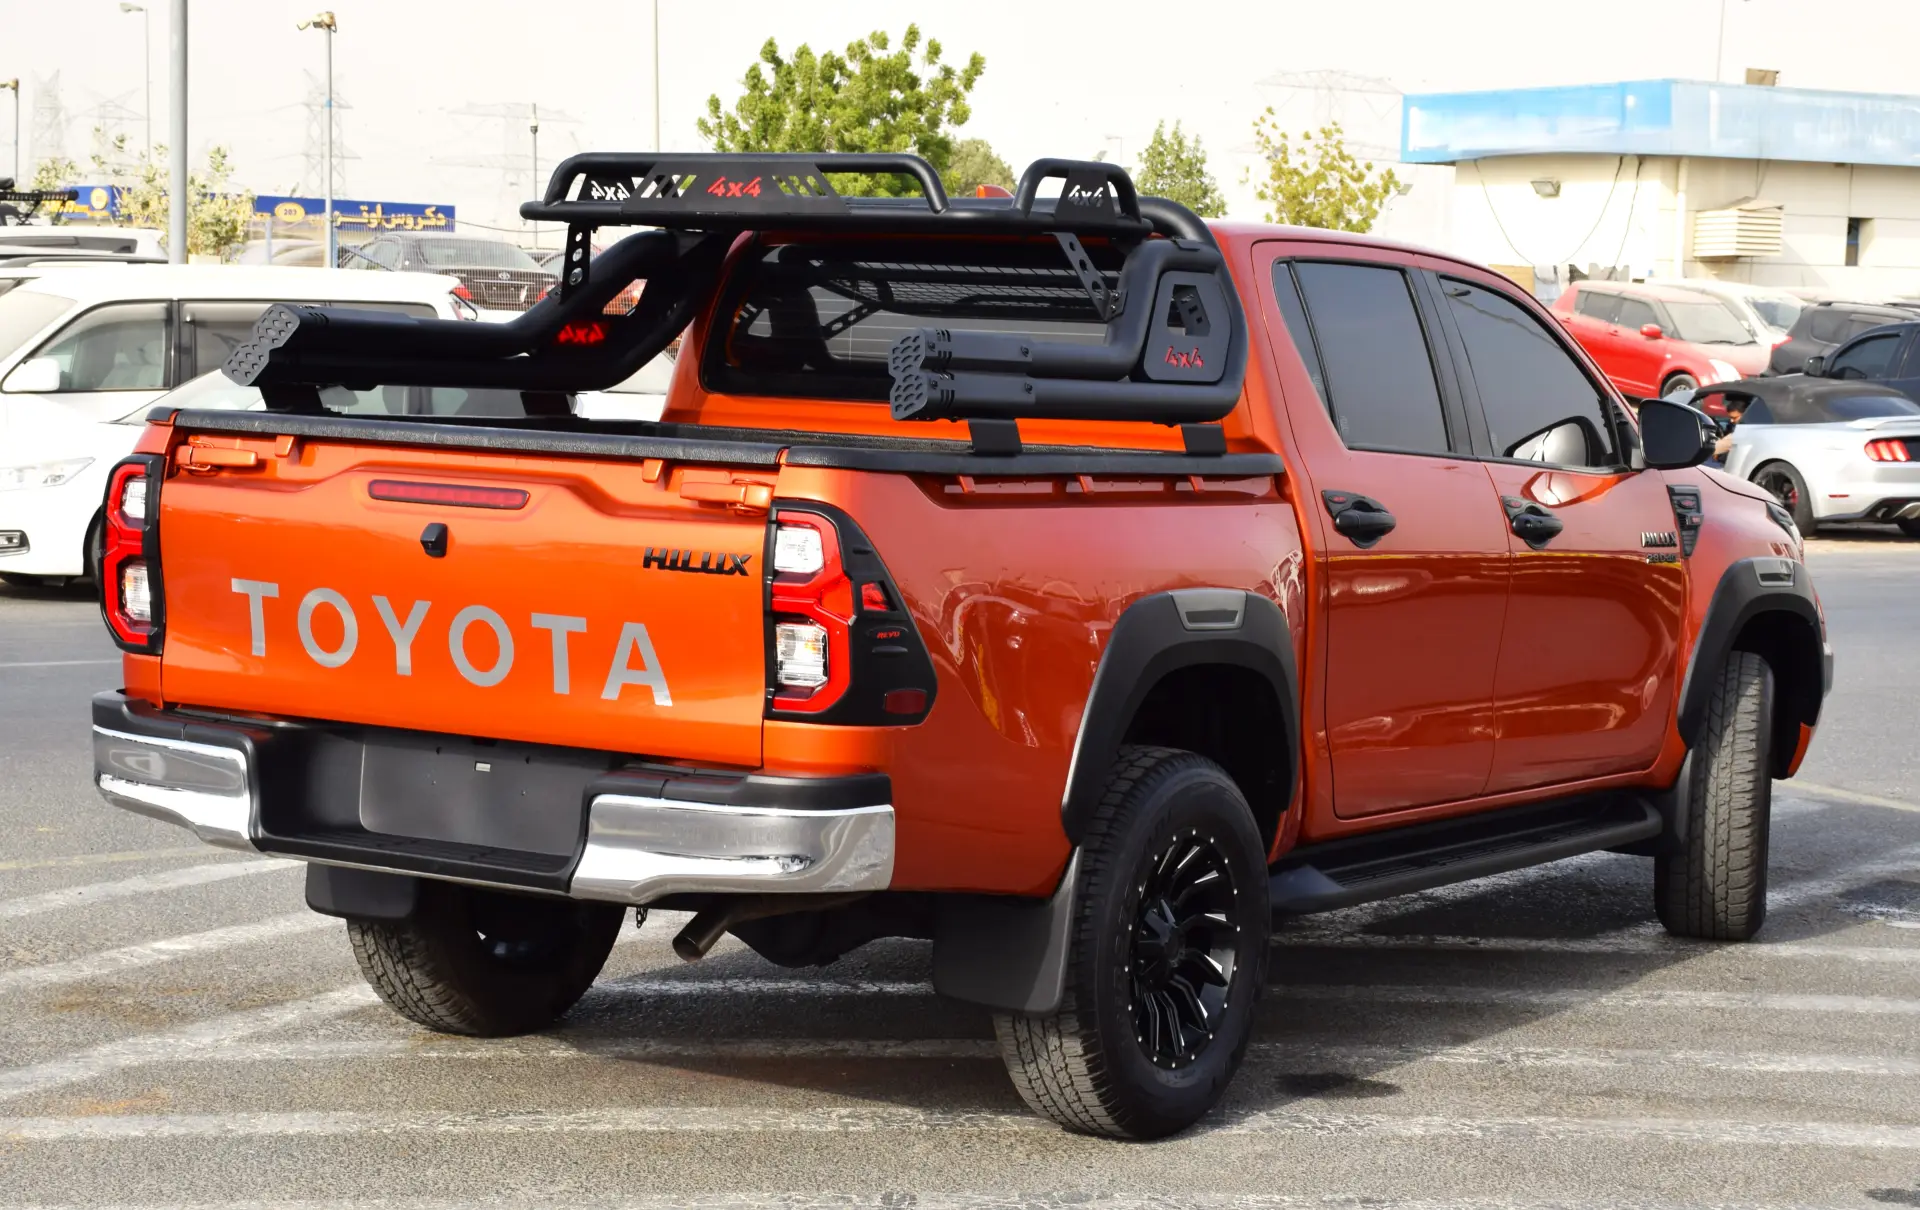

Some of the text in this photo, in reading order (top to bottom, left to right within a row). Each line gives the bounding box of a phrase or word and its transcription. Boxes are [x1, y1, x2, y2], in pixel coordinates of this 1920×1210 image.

[708, 176, 762, 197] 4x4
[1068, 184, 1104, 207] 4x4
[1164, 345, 1204, 369] 4x4
[643, 546, 752, 577] HILUX
[231, 577, 673, 707] TOYOTA
